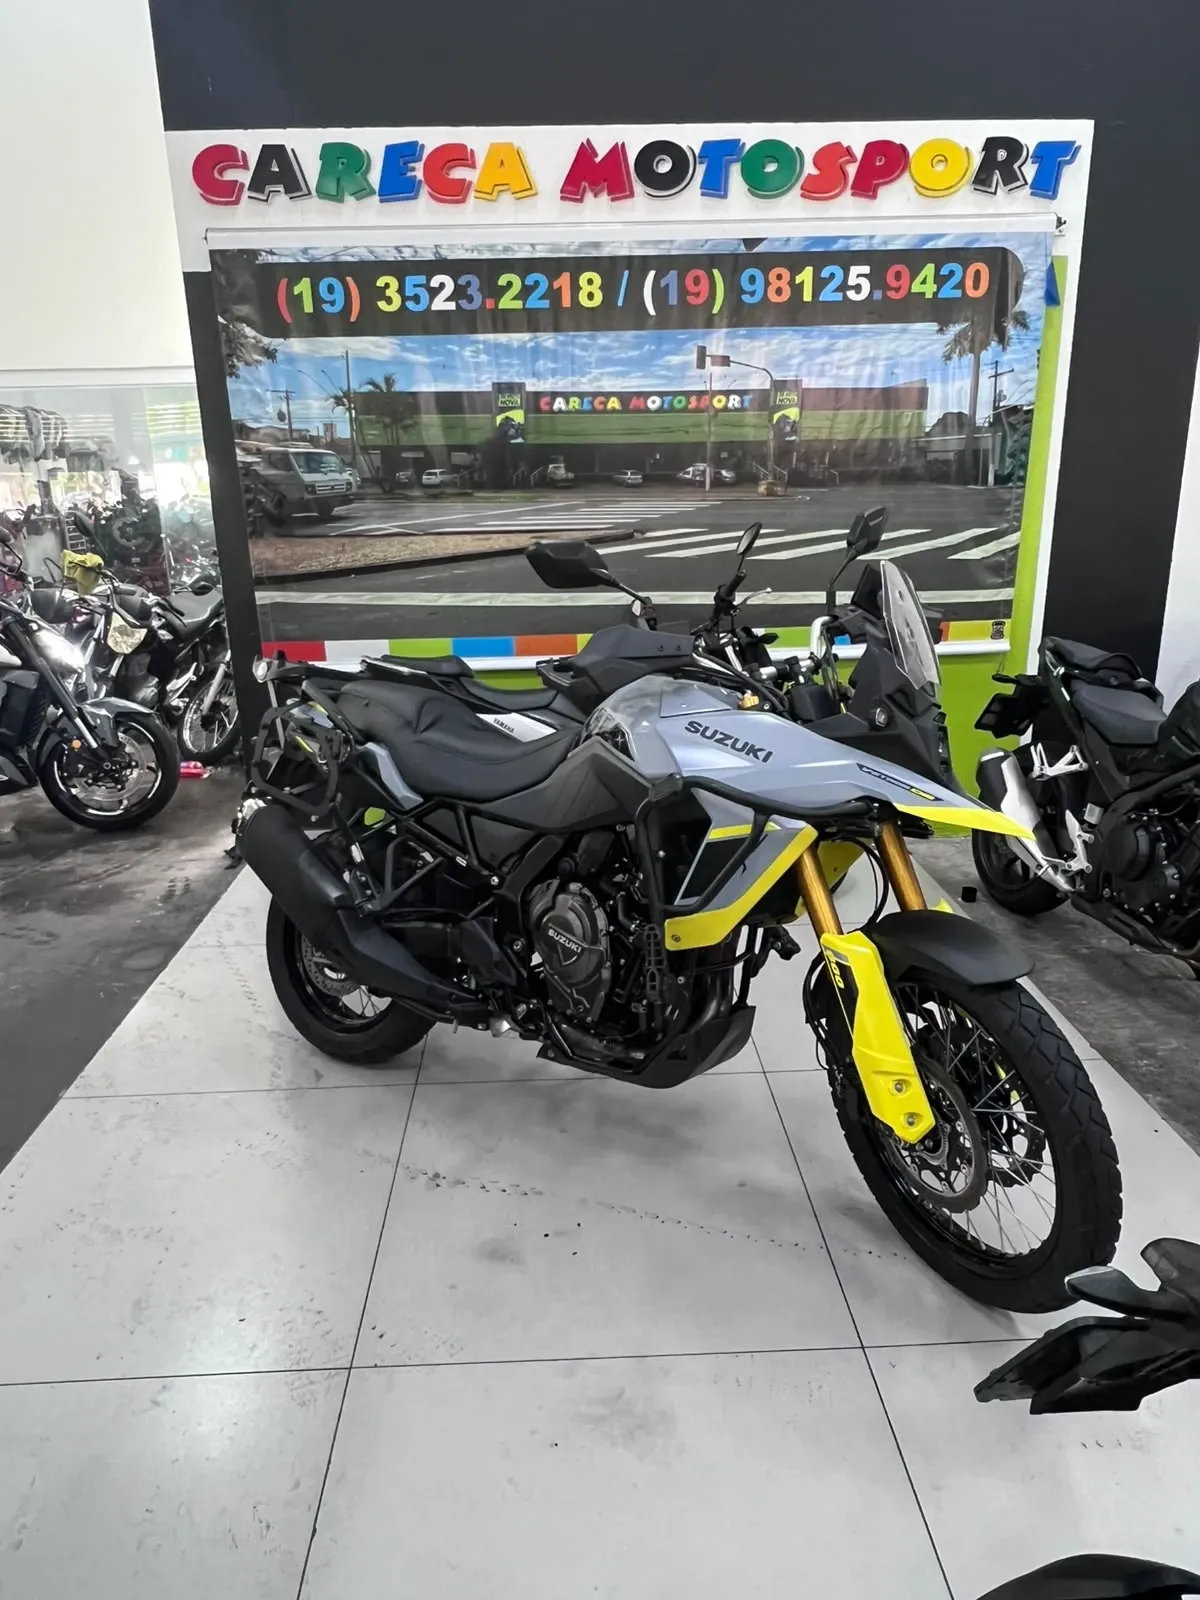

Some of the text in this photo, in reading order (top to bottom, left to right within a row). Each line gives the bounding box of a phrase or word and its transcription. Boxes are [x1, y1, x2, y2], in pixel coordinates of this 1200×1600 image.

[191, 137, 1081, 206] CARECA MOTOSPORT
[277, 276, 361, 324] (19)
[376, 271, 604, 313] 3523.2218
[643, 267, 725, 316] (19)
[740, 262, 991, 304] 98125.9420
[540, 395, 622, 413] CARECA
[628, 395, 753, 411] MOTOSPORT
[493, 717, 515, 734] YAMAHA
[684, 720, 774, 763] SUZUKI
[547, 928, 582, 953] SUZUKI
